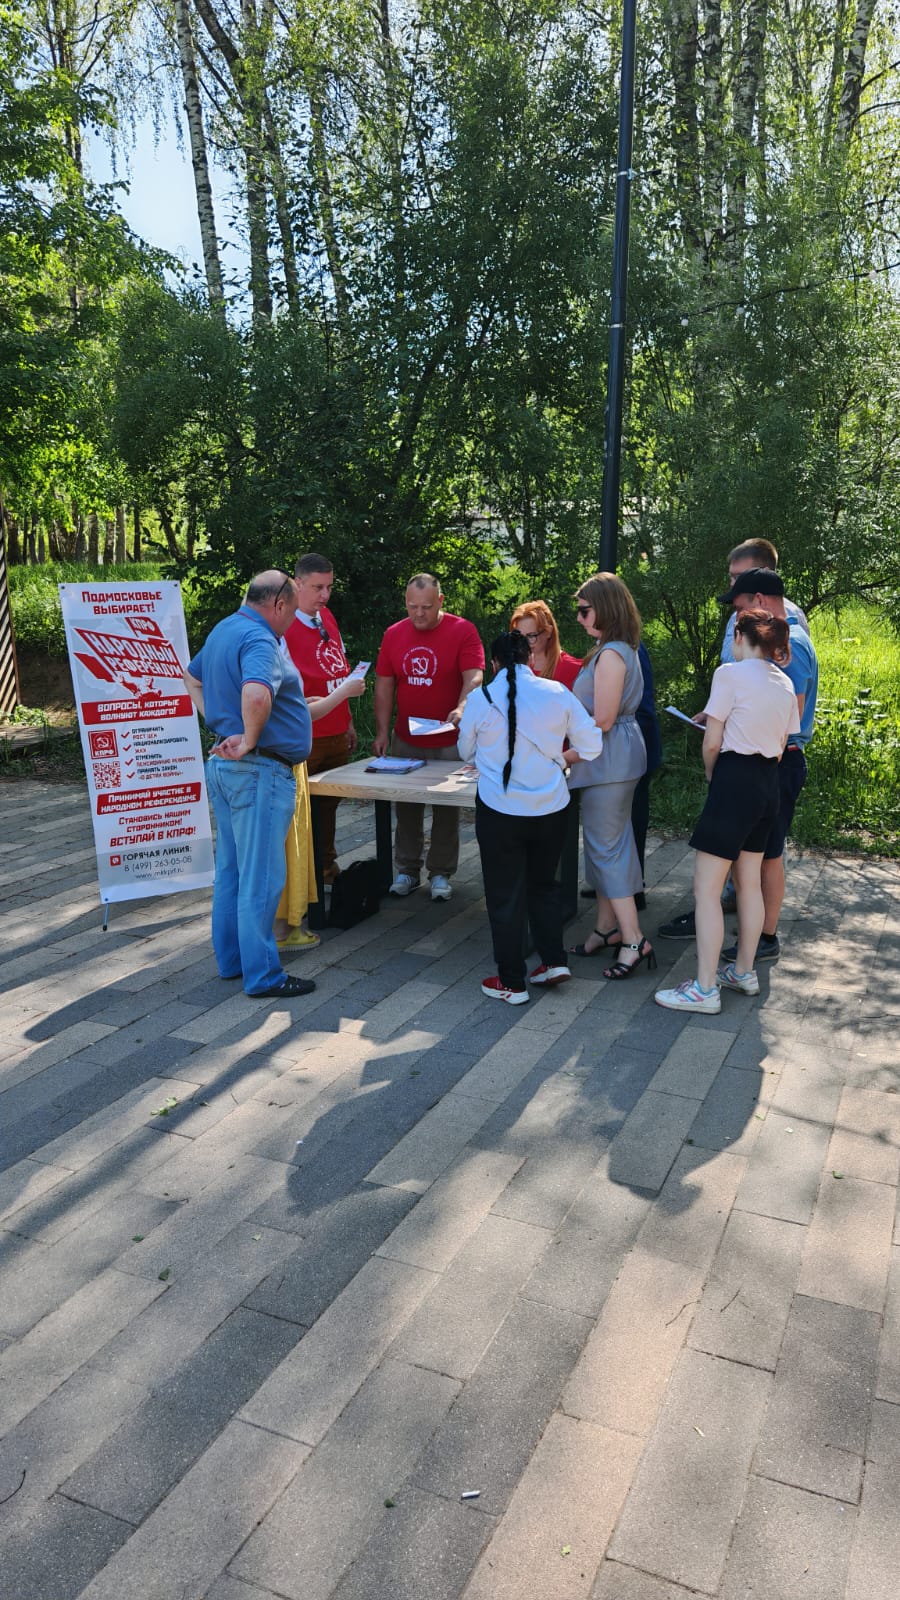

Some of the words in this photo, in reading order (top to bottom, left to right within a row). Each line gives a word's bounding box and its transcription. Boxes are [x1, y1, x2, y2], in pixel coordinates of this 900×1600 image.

[93, 603, 156, 615] ВЫБИРАЕТ!
[132, 617, 156, 632] КПРФ
[84, 632, 176, 663] НАРОДНЫЙ
[106, 656, 184, 678] РЕФЕРЕНДУМ
[408, 676, 432, 686] КПРФ
[97, 702, 142, 712] ВОПРОСЫ,
[144, 699, 180, 708] КОТОРЫЕ
[100, 711, 137, 721] ВОЛНУЮТ
[139, 707, 176, 717] КАЖДОГО!
[152, 788, 184, 799] УЧАСТИЕ
[101, 802, 143, 813] НАРОДНОМ
[144, 794, 197, 809] РЕФЕРЕНДУМЕ
[165, 809, 191, 819] НАШИМ
[127, 819, 183, 833] СТОРОННИКОМ!
[110, 831, 155, 847] ВСТУПАЙ
[157, 831, 165, 840] В
[167, 827, 196, 839] КПРФ!
[123, 848, 160, 862] ГОРЯЧАЯ
[162, 845, 192, 856] ЛИНИЯ:
[132, 861, 152, 872] (499)
